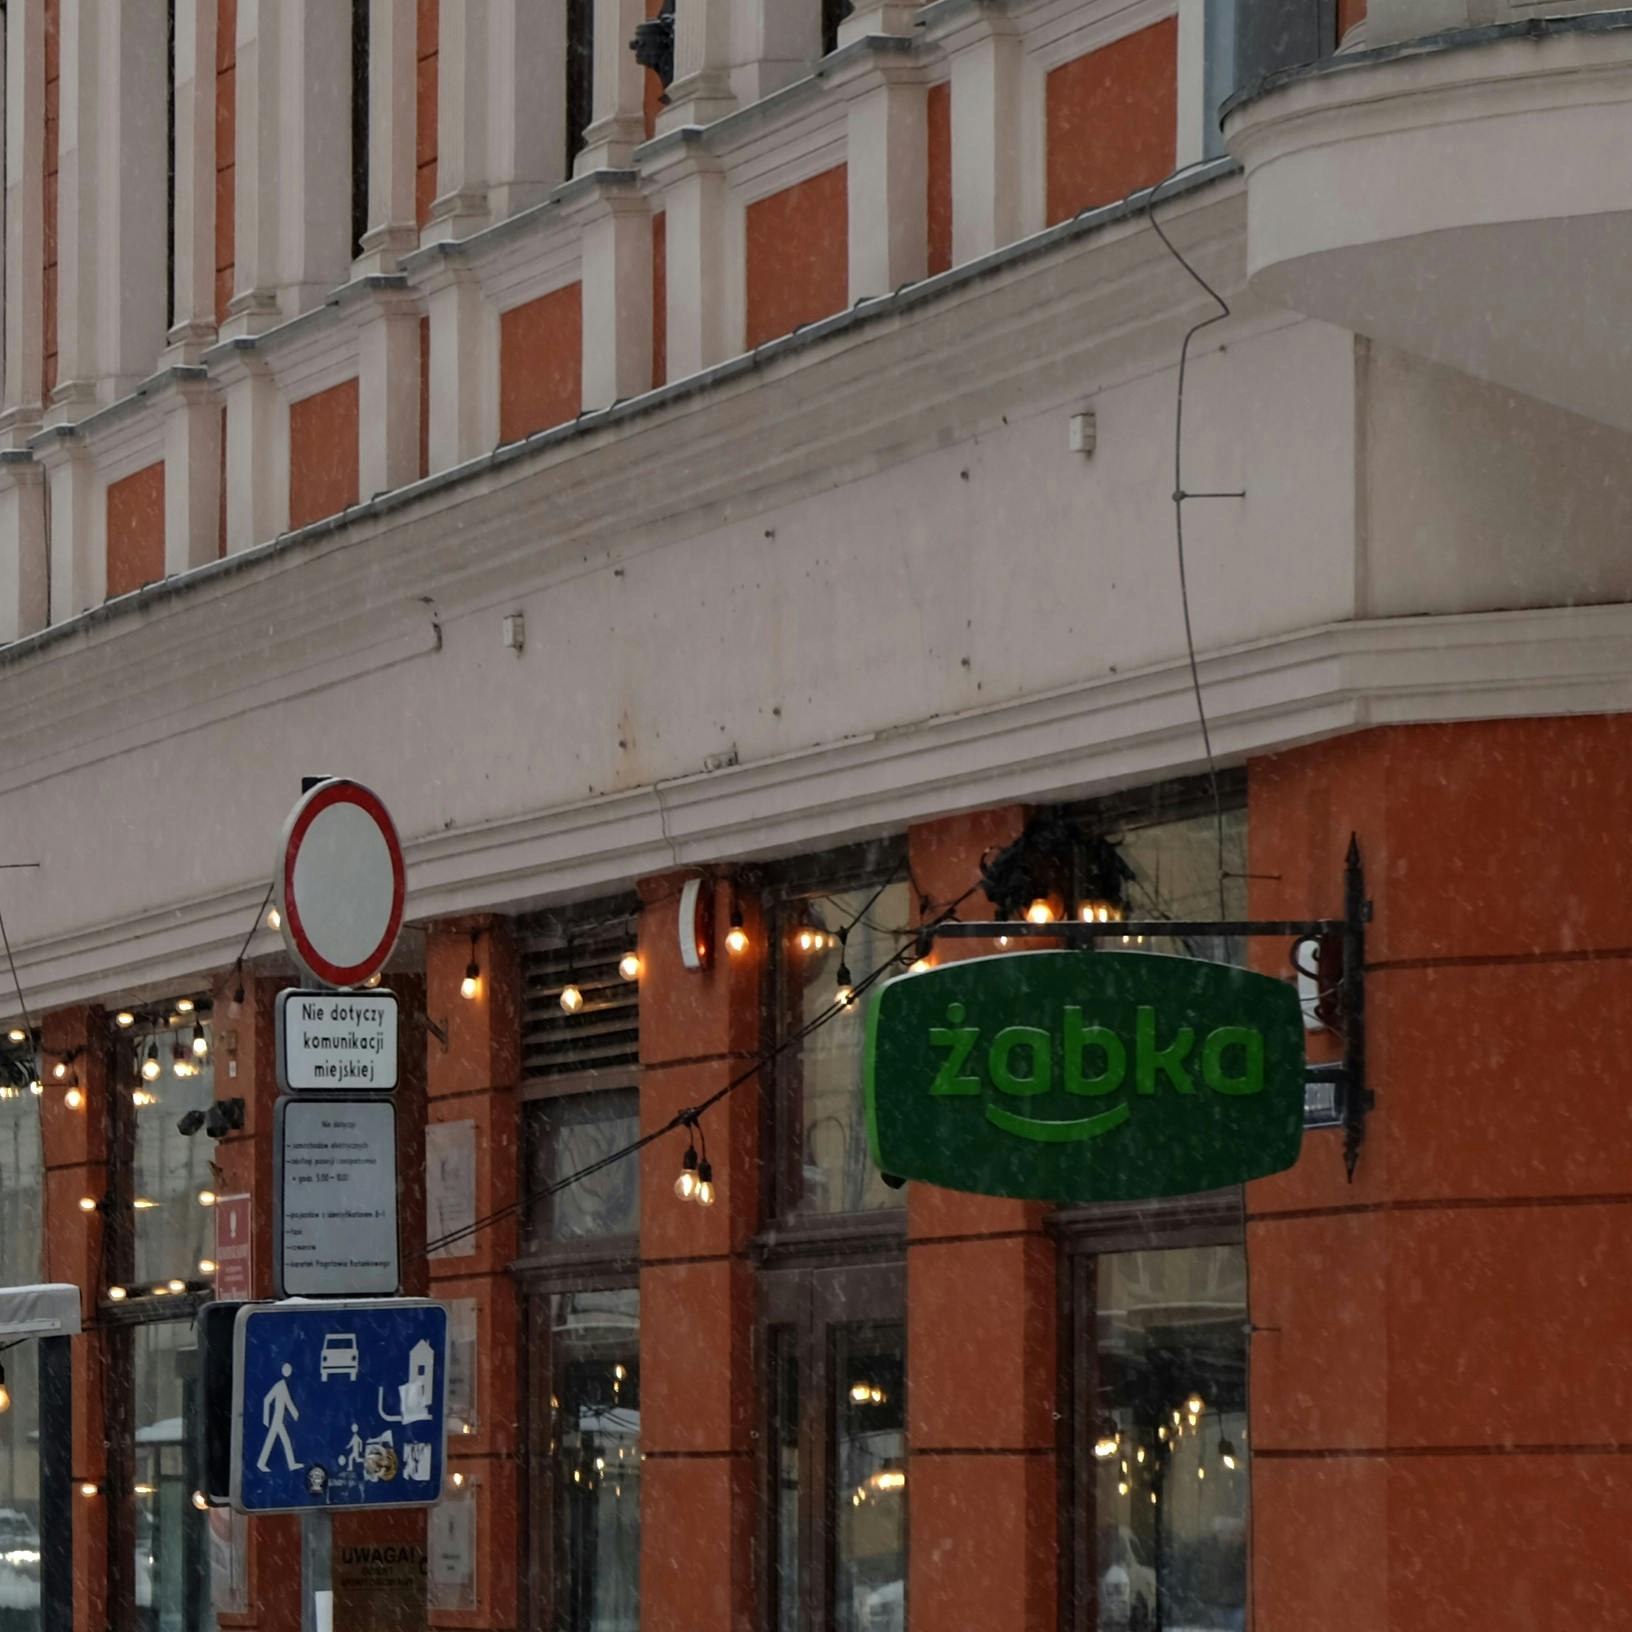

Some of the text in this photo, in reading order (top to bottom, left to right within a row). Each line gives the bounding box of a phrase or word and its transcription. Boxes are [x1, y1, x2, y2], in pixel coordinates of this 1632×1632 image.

[302, 1003, 385, 1028] Nie dotyczy
[303, 1031, 384, 1055] komunikacji
[928, 1001, 1265, 1096] żabka
[314, 1060, 375, 1083] miejskiej
[340, 1546, 416, 1565] UWAGA!
